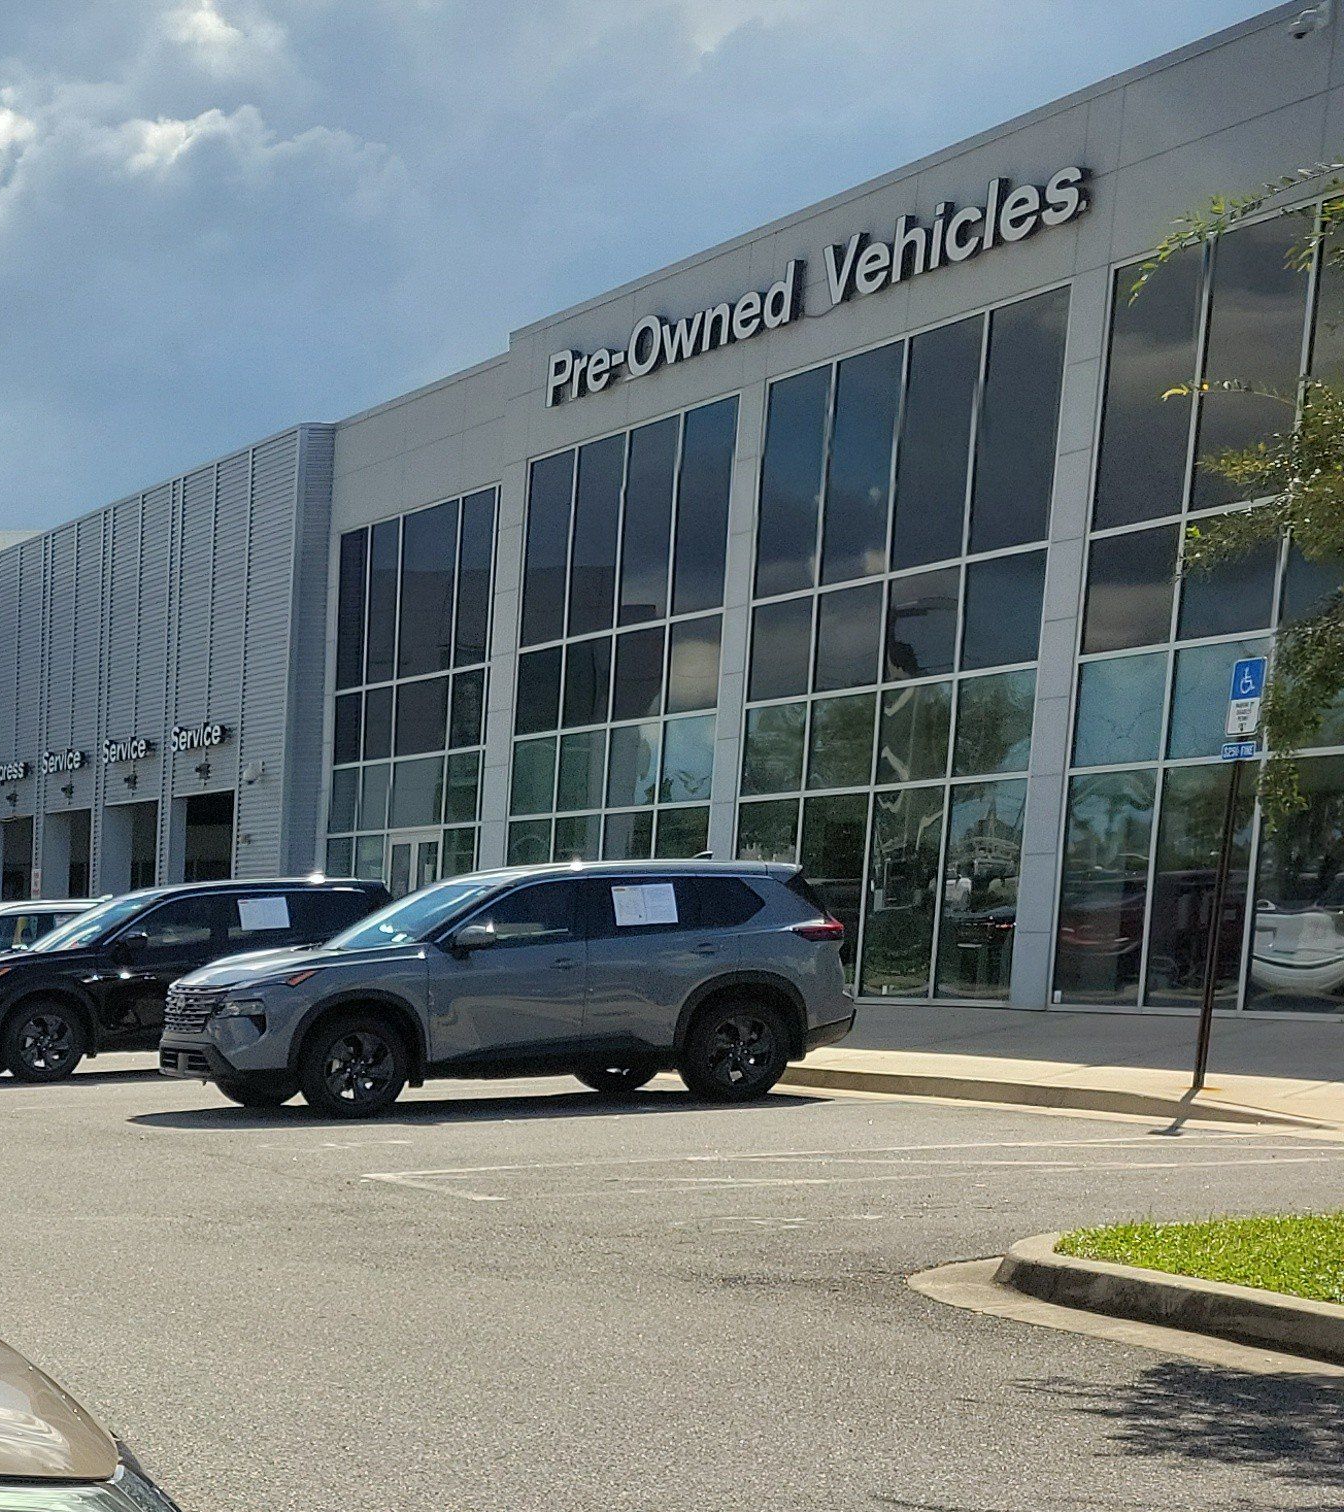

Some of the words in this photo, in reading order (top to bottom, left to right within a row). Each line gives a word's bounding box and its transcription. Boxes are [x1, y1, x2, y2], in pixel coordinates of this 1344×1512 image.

[545, 260, 796, 408] Pre-Owned
[823, 165, 1083, 306] Vehicles
[102, 736, 148, 764] Service
[171, 724, 222, 753] Service
[42, 750, 83, 775] Service
